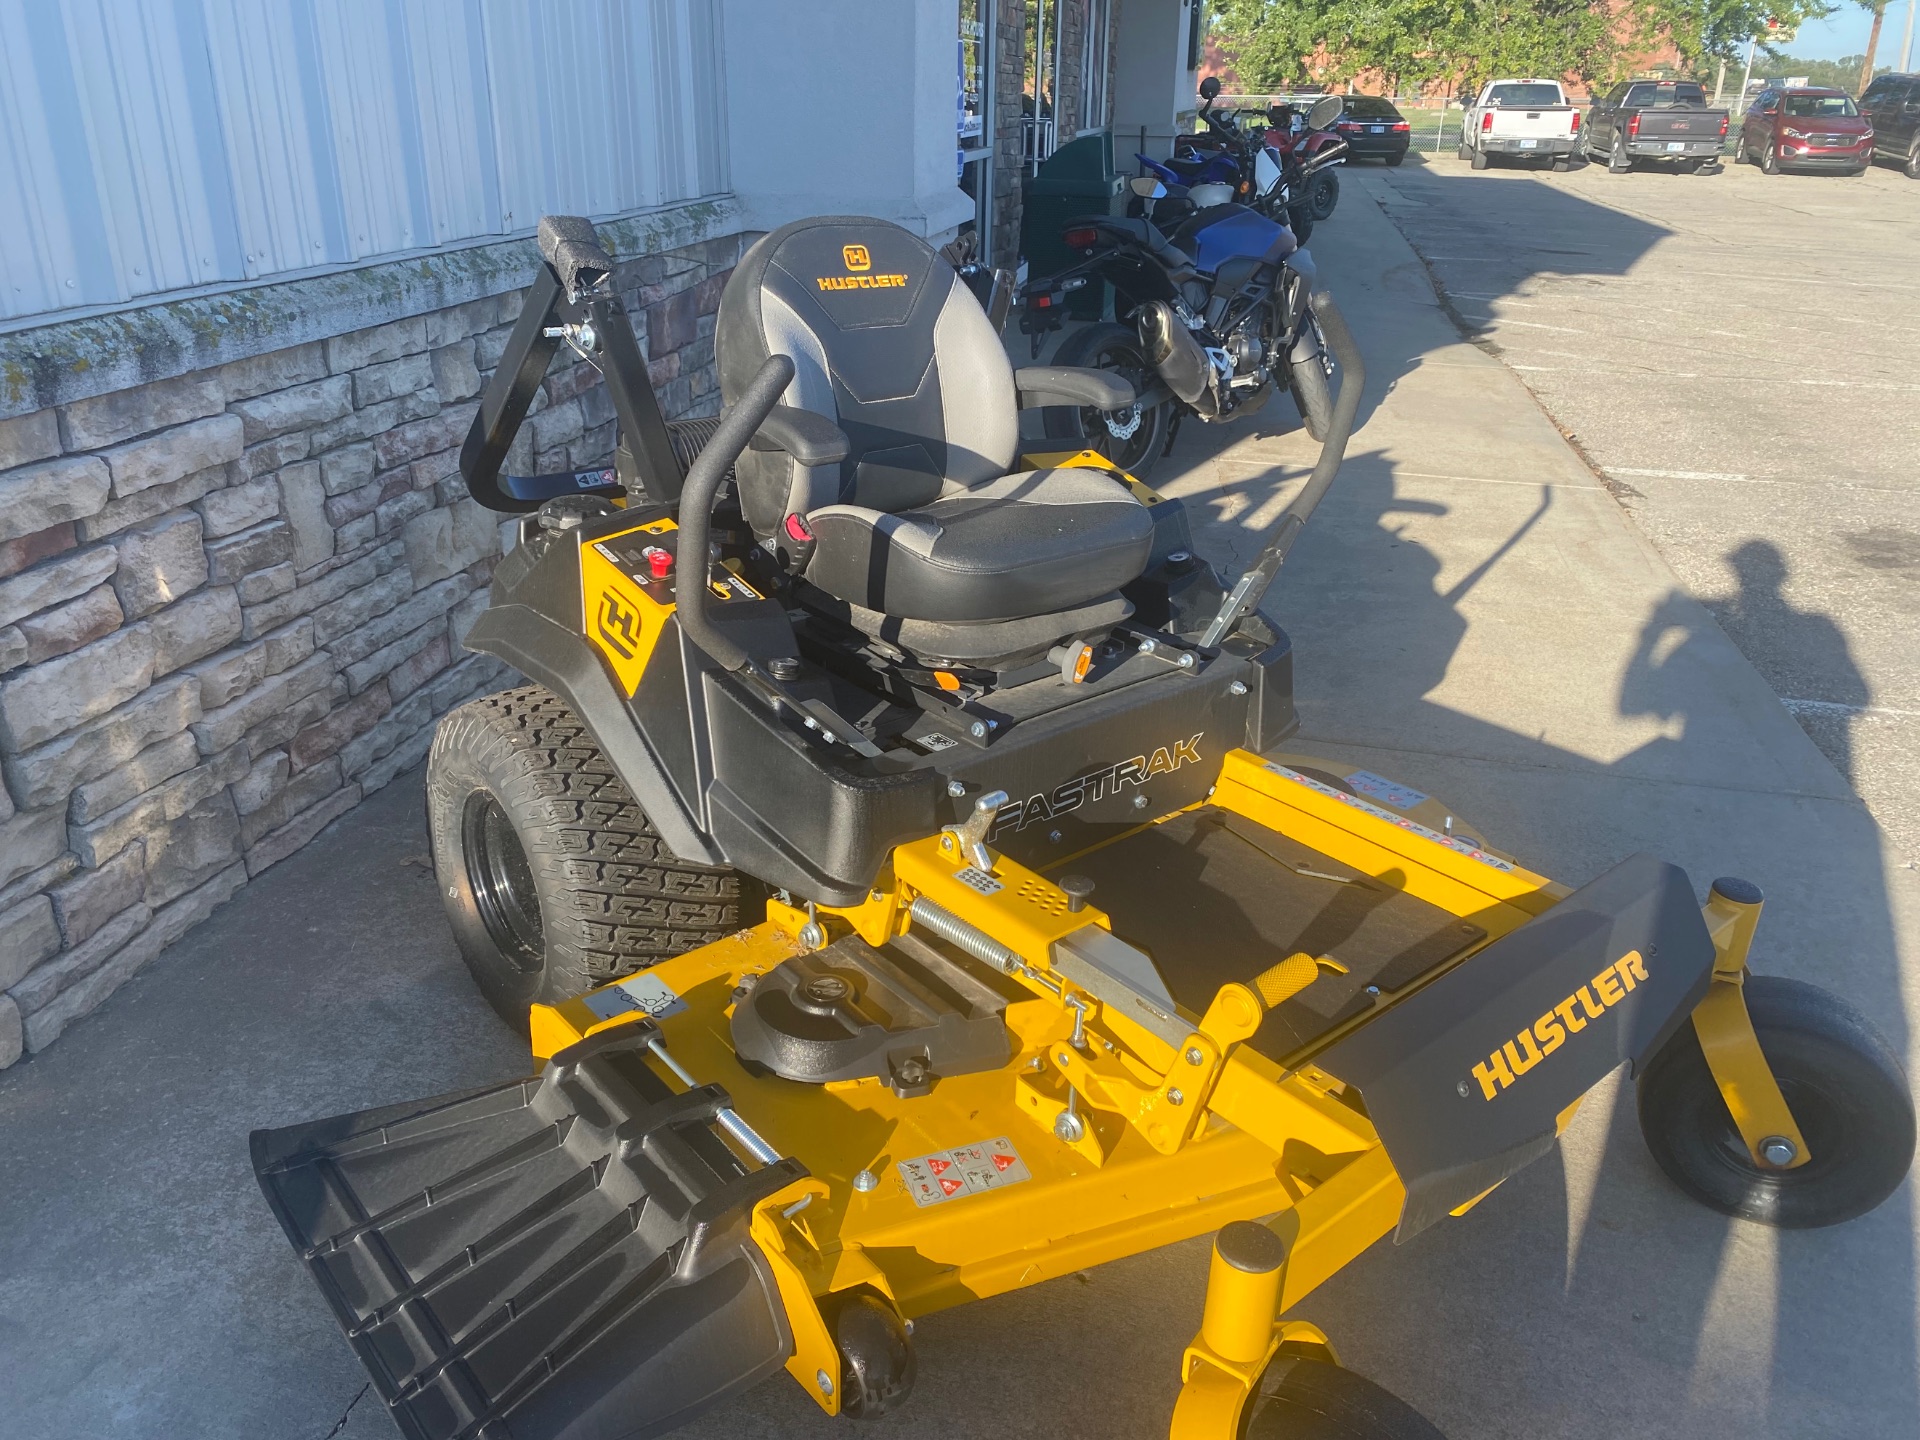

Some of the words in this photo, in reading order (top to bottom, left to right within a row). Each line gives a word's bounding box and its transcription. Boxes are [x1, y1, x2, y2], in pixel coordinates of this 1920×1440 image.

[817, 274, 906, 291] HUSTLER
[986, 731, 1205, 844] FASTRAK
[1470, 949, 1650, 1102] HUSTLER
